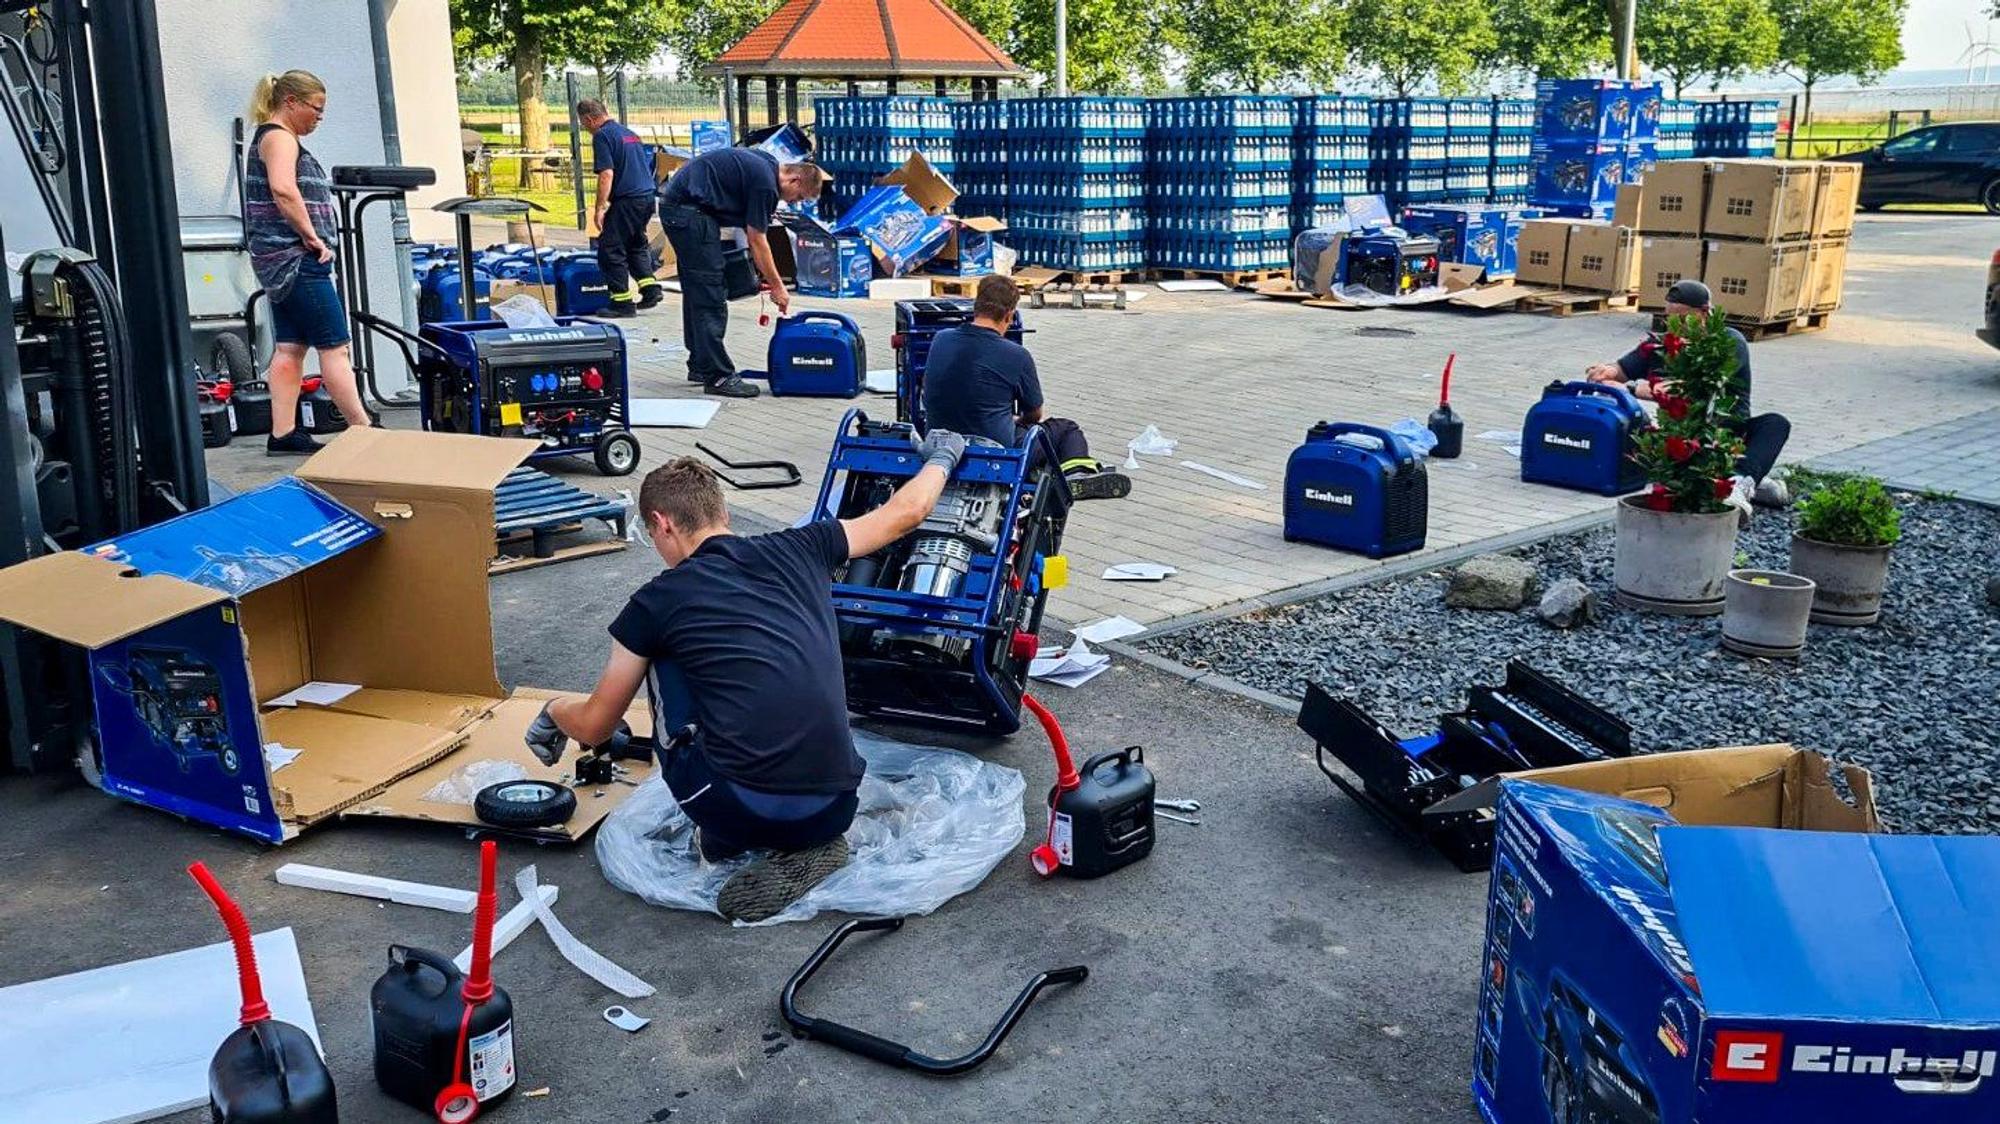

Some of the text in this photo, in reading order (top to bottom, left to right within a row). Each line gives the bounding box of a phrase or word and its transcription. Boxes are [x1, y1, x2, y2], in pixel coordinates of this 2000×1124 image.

[509, 330, 585, 342] Einhell
[792, 356, 833, 366] Einhell
[1544, 433, 1591, 450] Einhell
[1305, 488, 1353, 506] Einhell
[1791, 1045, 1997, 1077] Einhell
[1597, 1056, 1642, 1105] Einhell
